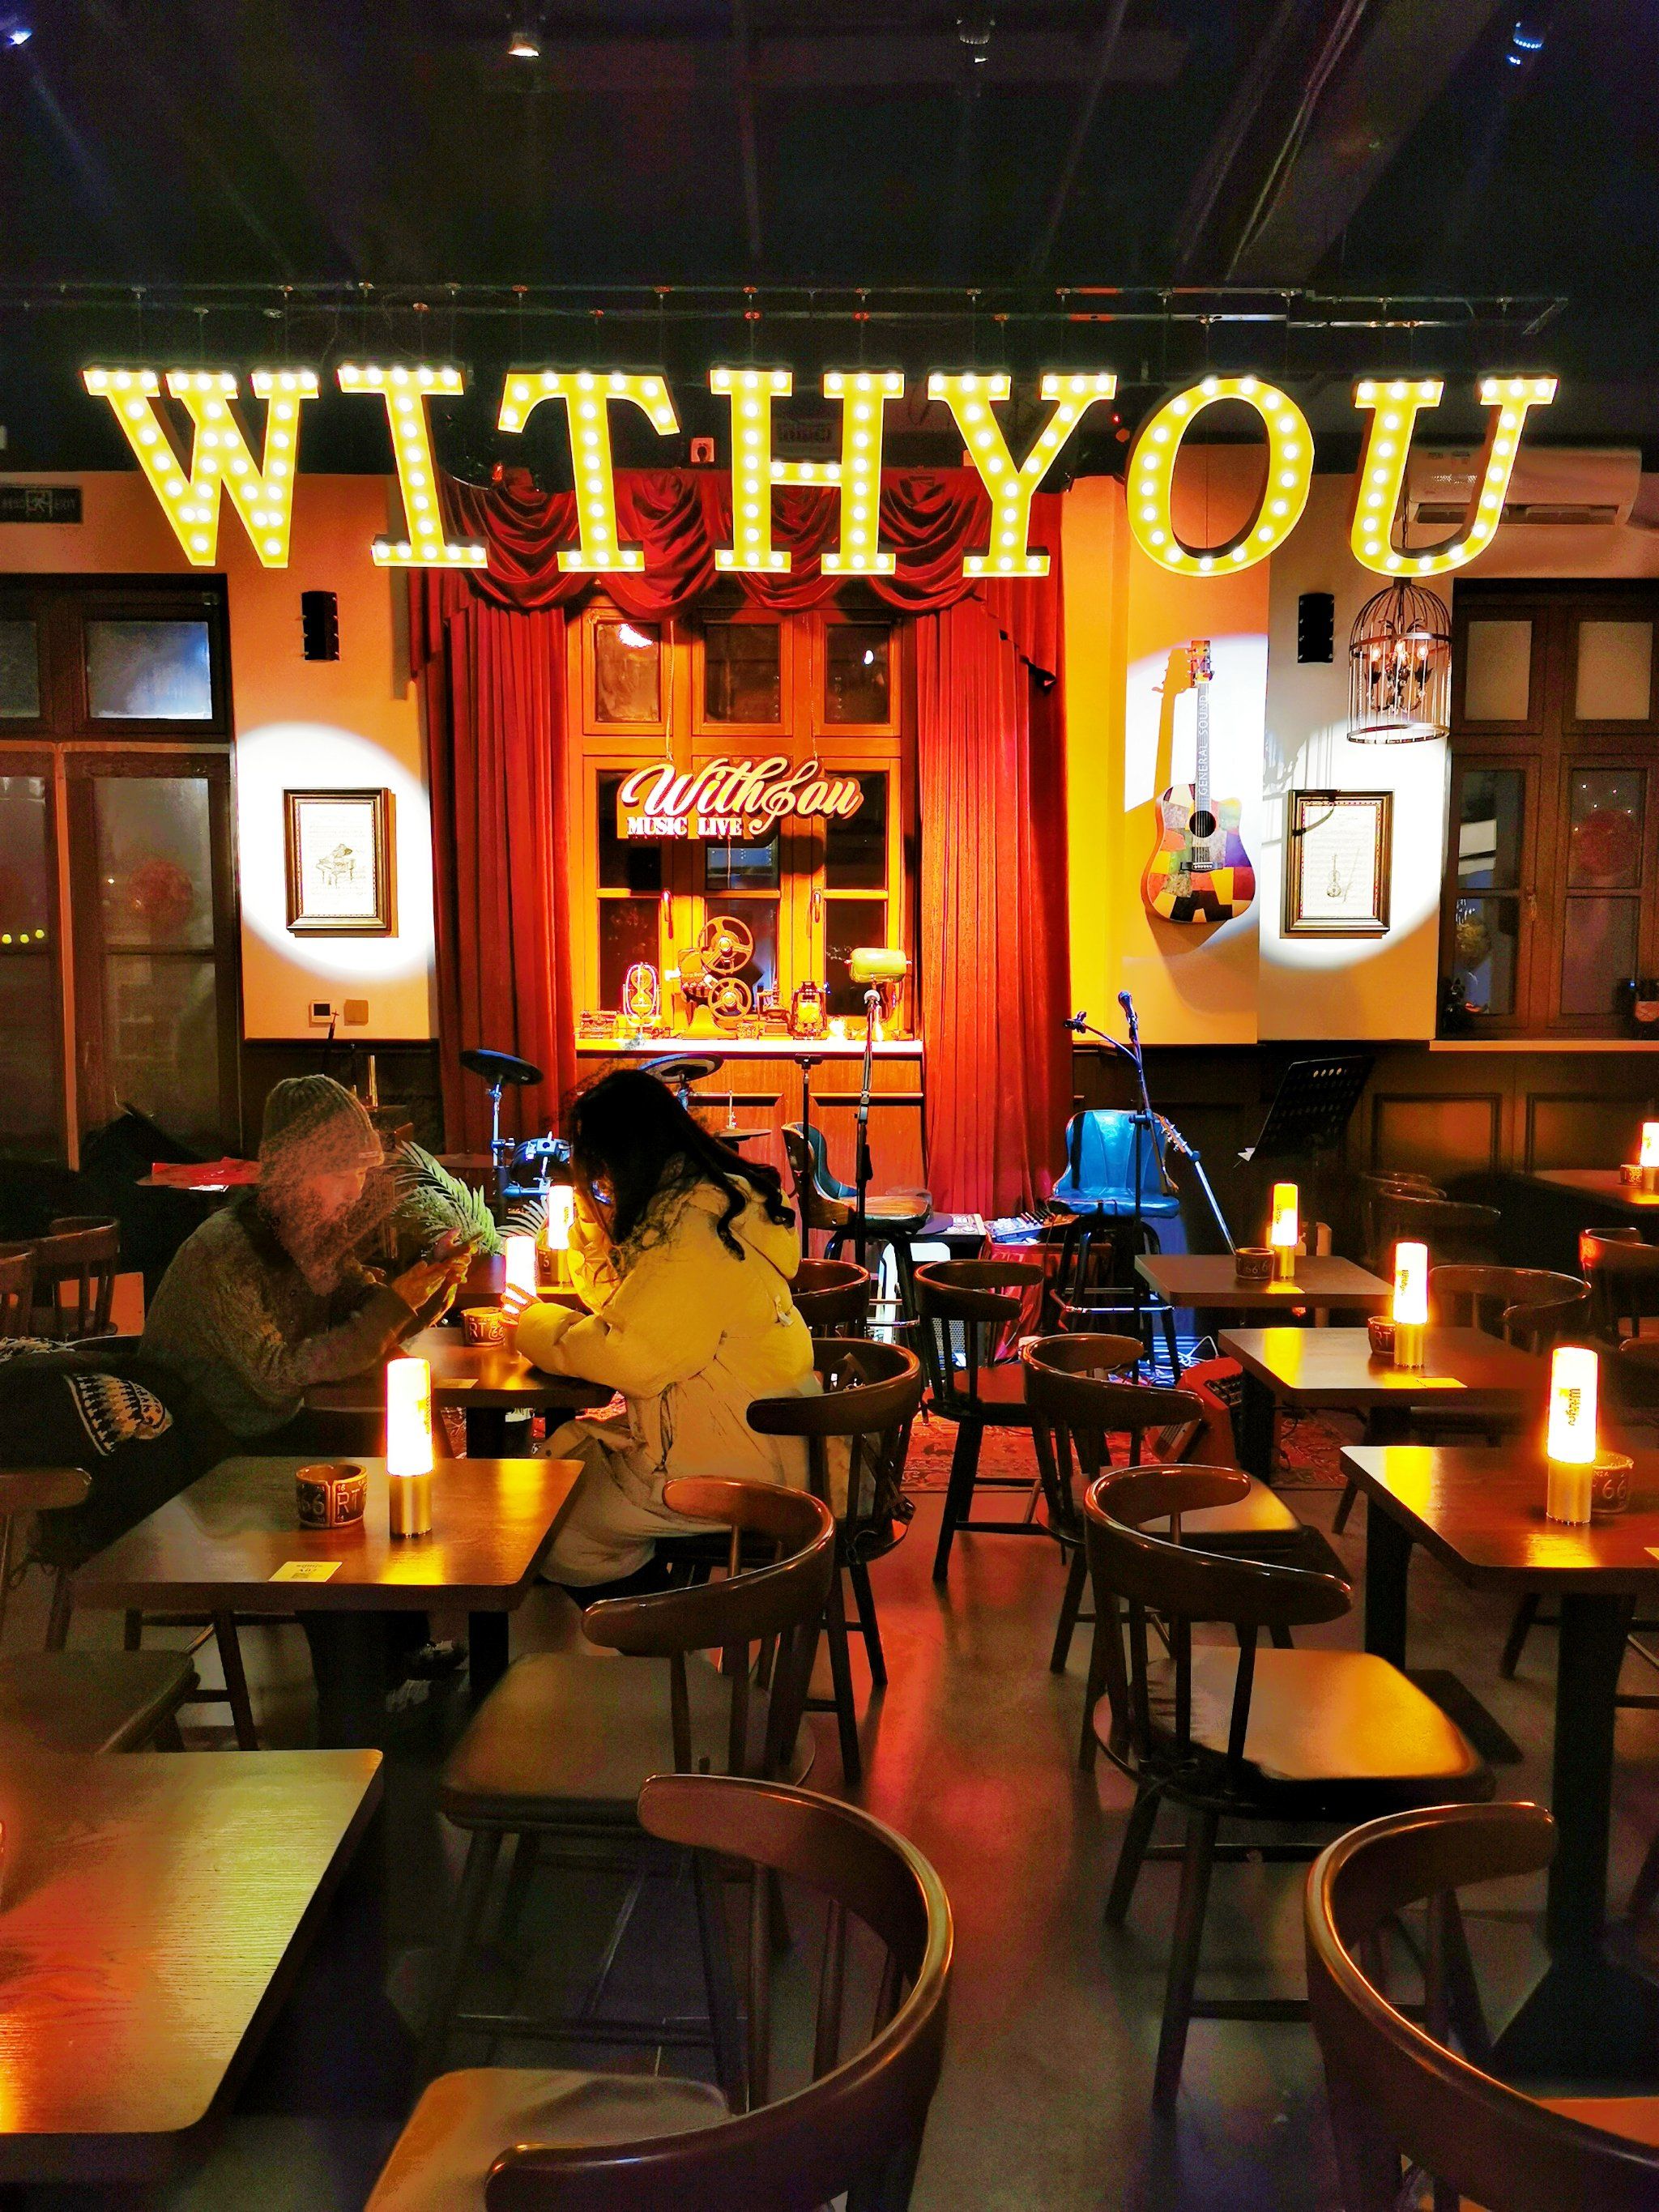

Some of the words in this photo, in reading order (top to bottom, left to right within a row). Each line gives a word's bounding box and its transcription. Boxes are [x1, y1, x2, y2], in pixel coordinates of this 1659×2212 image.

[1198, 694, 1209, 735] SOUND
[1198, 743, 1209, 796] GENERAL
[627, 816, 689, 836] MUSIC
[696, 816, 743, 836] LIVE
[337, 1488, 360, 1515] RT
